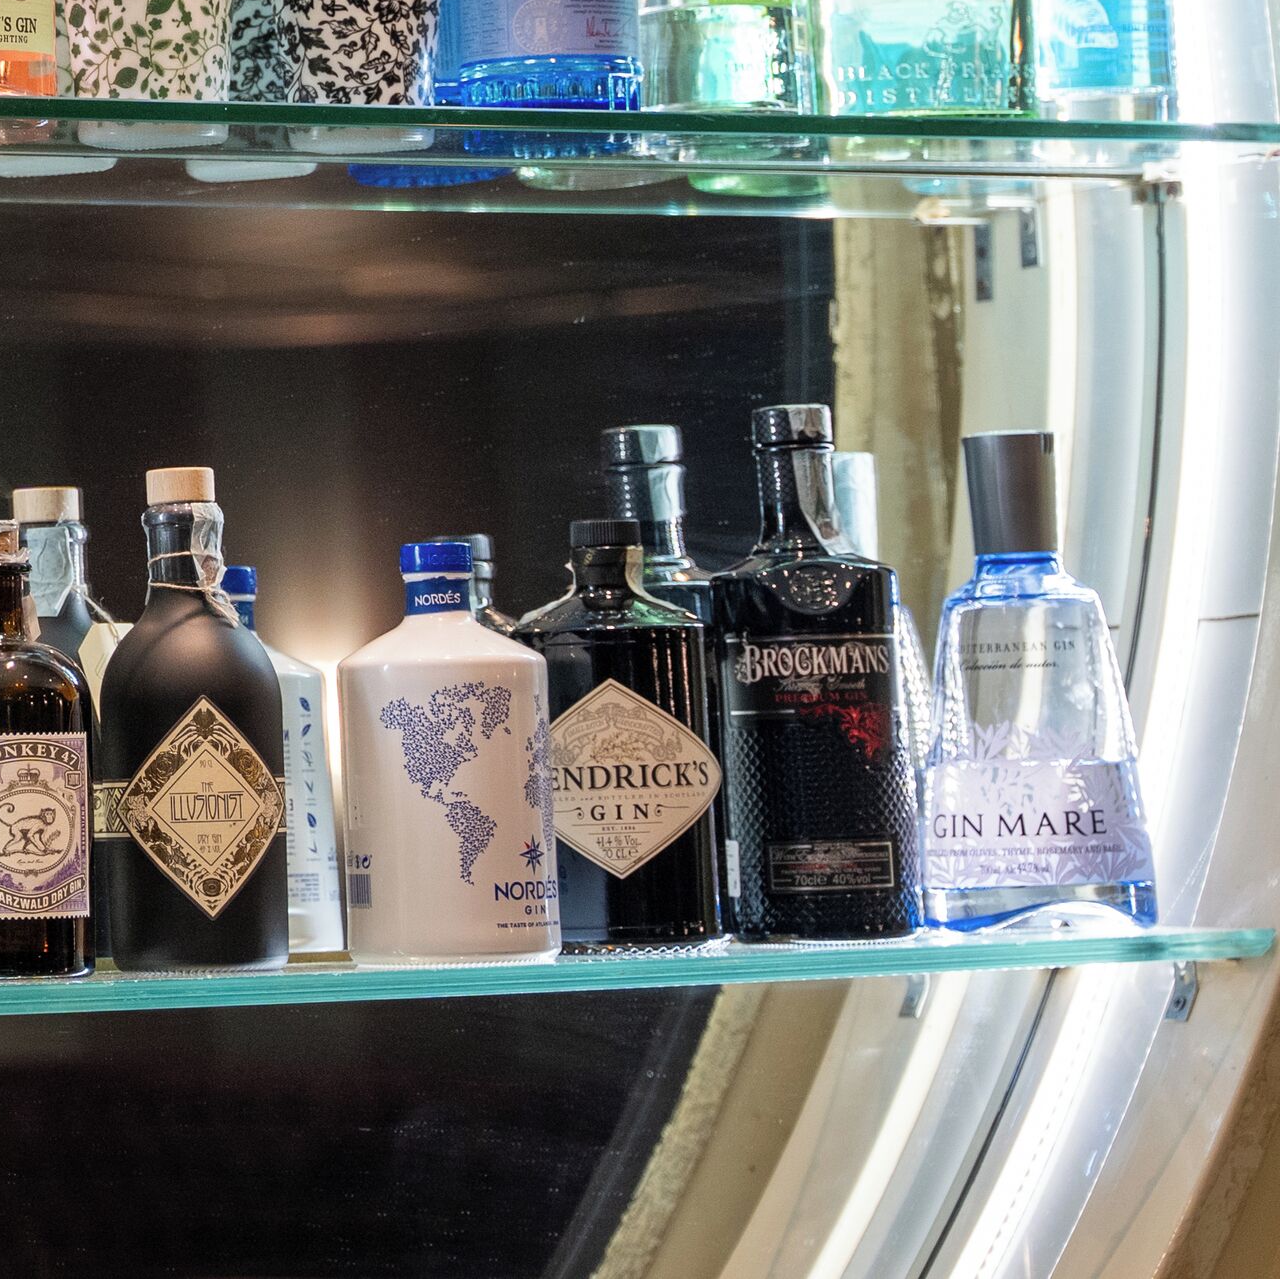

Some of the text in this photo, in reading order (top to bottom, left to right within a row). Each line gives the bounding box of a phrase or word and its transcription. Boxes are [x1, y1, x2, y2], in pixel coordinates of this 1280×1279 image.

[16, 17, 37, 34] GIN
[415, 590, 460, 606] NORDÉS
[1054, 641, 1076, 650] GIN
[736, 644, 889, 683] BROCKMANS
[62, 752, 78, 766] 47
[553, 761, 709, 791] ENDRICK'S
[170, 794, 243, 821] ILLUSIONIST
[591, 803, 649, 821] GIN
[934, 810, 1108, 839] GIN MARE
[51, 886, 68, 904] DRY
[70, 879, 82, 893] GIN
[495, 875, 557, 901] NORDÉS
[525, 905, 545, 915] GIN
